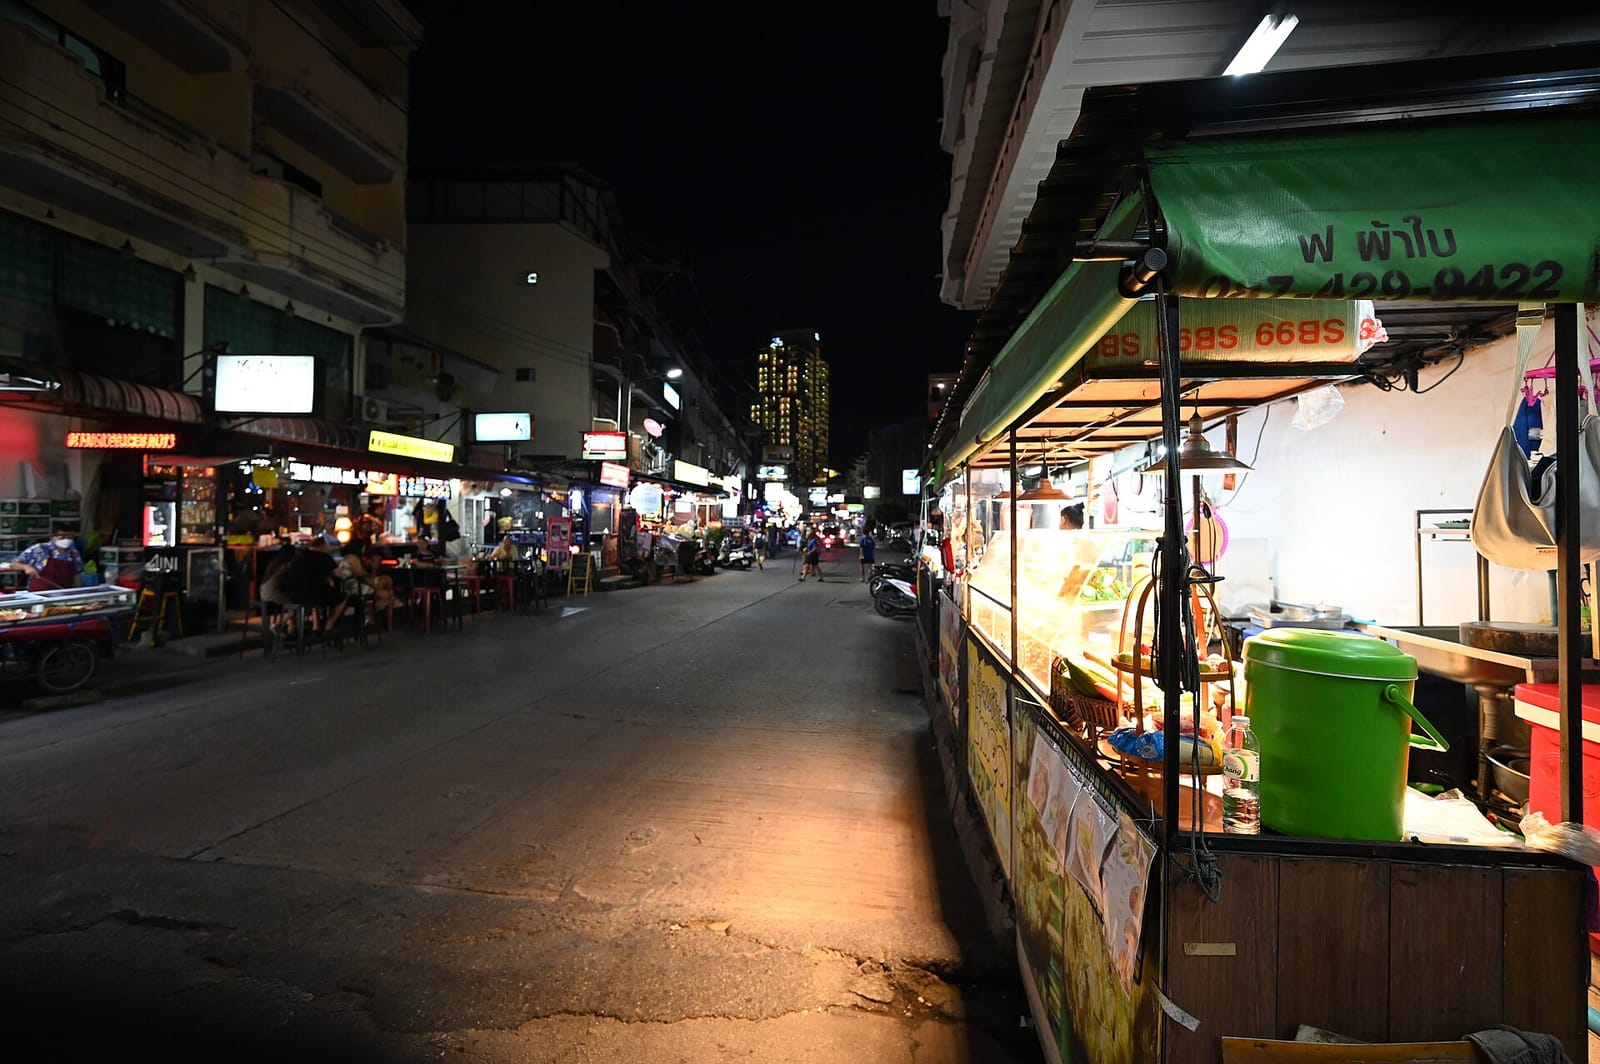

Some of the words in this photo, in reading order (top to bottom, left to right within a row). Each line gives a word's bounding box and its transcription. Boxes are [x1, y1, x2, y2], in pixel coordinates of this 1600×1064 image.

[1355, 215, 1457, 262] ผ้าใบ
[1168, 324, 1239, 352] SB9
[1255, 318, 1345, 346] SB99
